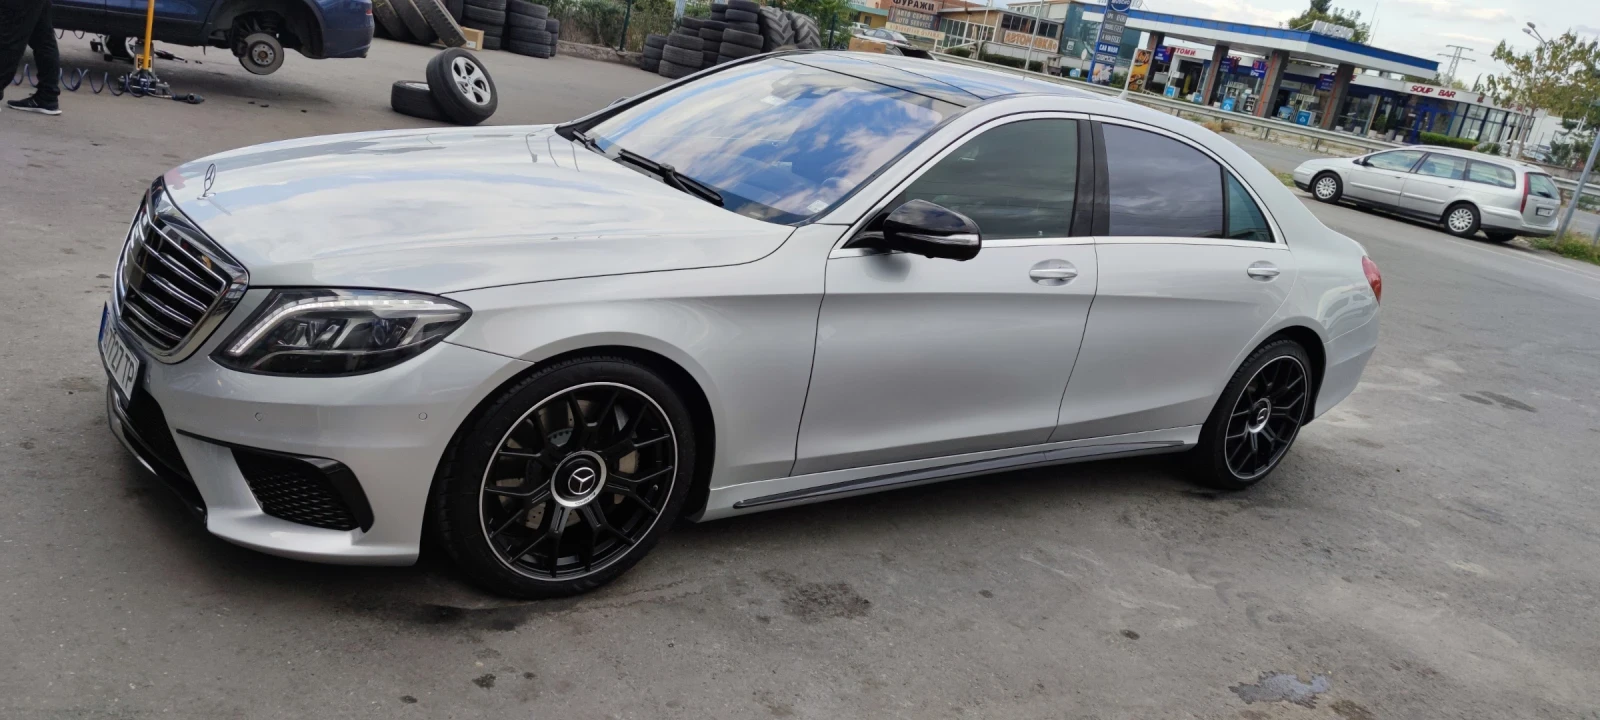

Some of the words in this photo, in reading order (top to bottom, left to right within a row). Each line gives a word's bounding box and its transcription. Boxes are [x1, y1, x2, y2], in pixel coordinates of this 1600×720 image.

[1098, 43, 1107, 51] CAR
[1107, 45, 1119, 54] WASH
[1410, 85, 1433, 94] SOUP
[1437, 89, 1456, 98] BAR
